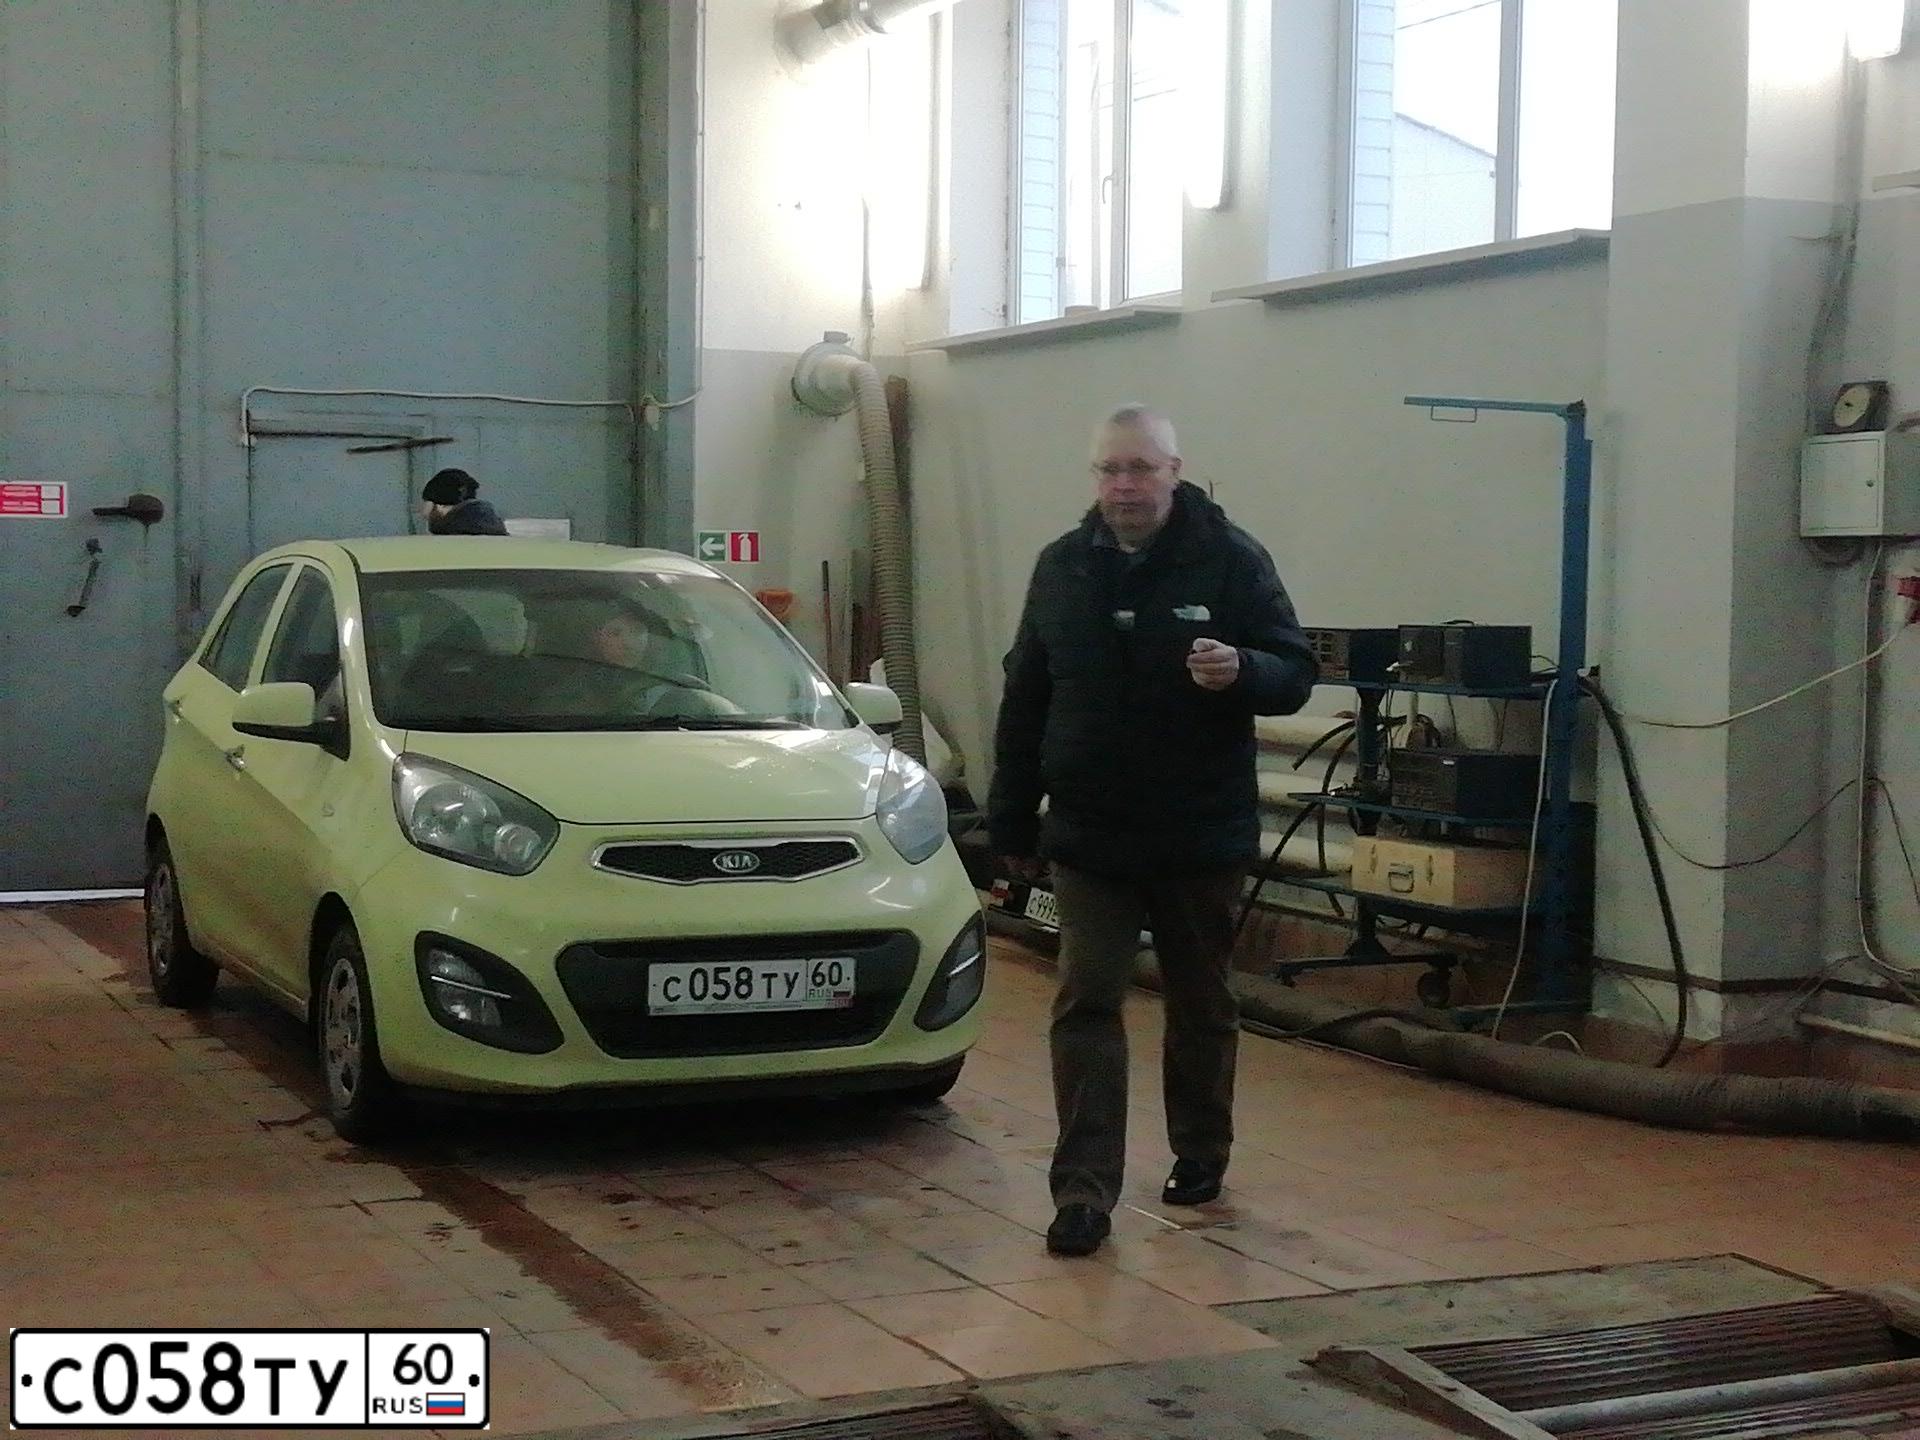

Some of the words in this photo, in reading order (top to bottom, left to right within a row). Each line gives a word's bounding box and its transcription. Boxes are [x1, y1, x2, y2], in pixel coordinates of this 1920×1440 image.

[721, 854, 752, 869] KIA
[811, 961, 843, 987] 60
[809, 988, 832, 999] RUS
